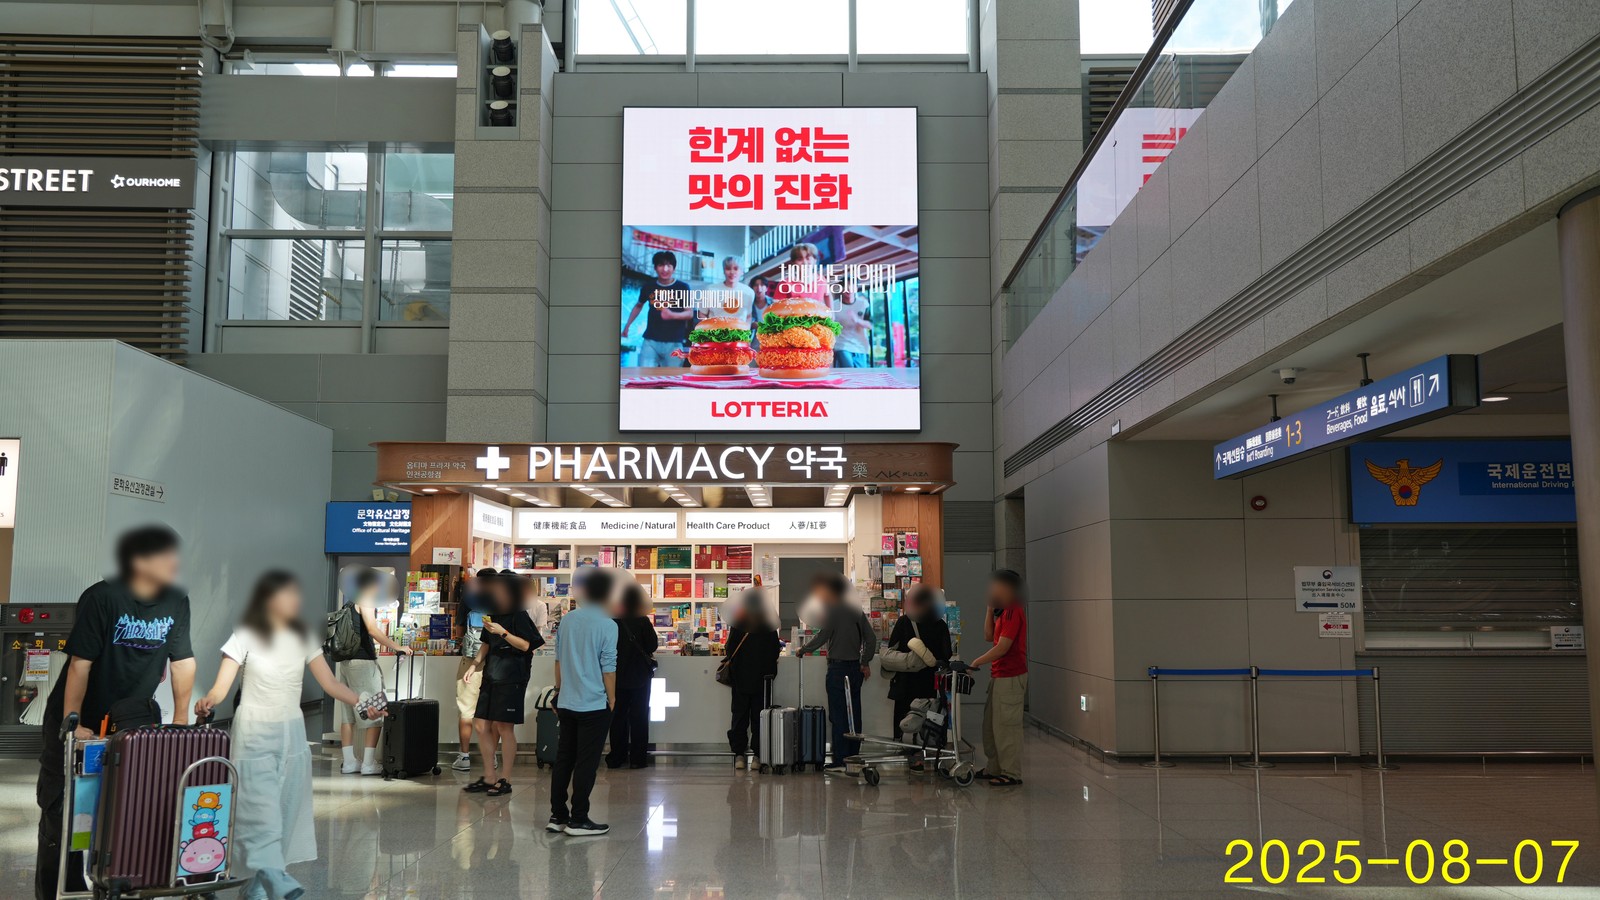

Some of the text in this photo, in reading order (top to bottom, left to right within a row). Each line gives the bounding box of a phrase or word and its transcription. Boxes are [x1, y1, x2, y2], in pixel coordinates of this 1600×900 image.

[688, 126, 850, 163] 한계 없는
[0, 168, 94, 192] STREET
[126, 177, 181, 187] OURHOME
[688, 173, 852, 210] 맛의 진화
[1389, 385, 1406, 409] 식사
[711, 401, 829, 418] LOTTERIA
[1326, 411, 1368, 435] Beverages, Food
[1285, 420, 1302, 447] 1-3
[452, 462, 467, 470] 약국
[528, 446, 775, 480] PHARMACY
[786, 446, 847, 479] 약국
[1487, 463, 1571, 479] 국제운전면
[875, 470, 901, 479] AK
[1491, 481, 1540, 489] International
[1541, 481, 1570, 489] Driving
[357, 509, 411, 520] 문화유산감정
[391, 527, 411, 535] Heritage
[533, 521, 588, 530] 健康機能食品
[687, 522, 770, 530] Health Care Product
[113, 613, 174, 643] THRASHE
